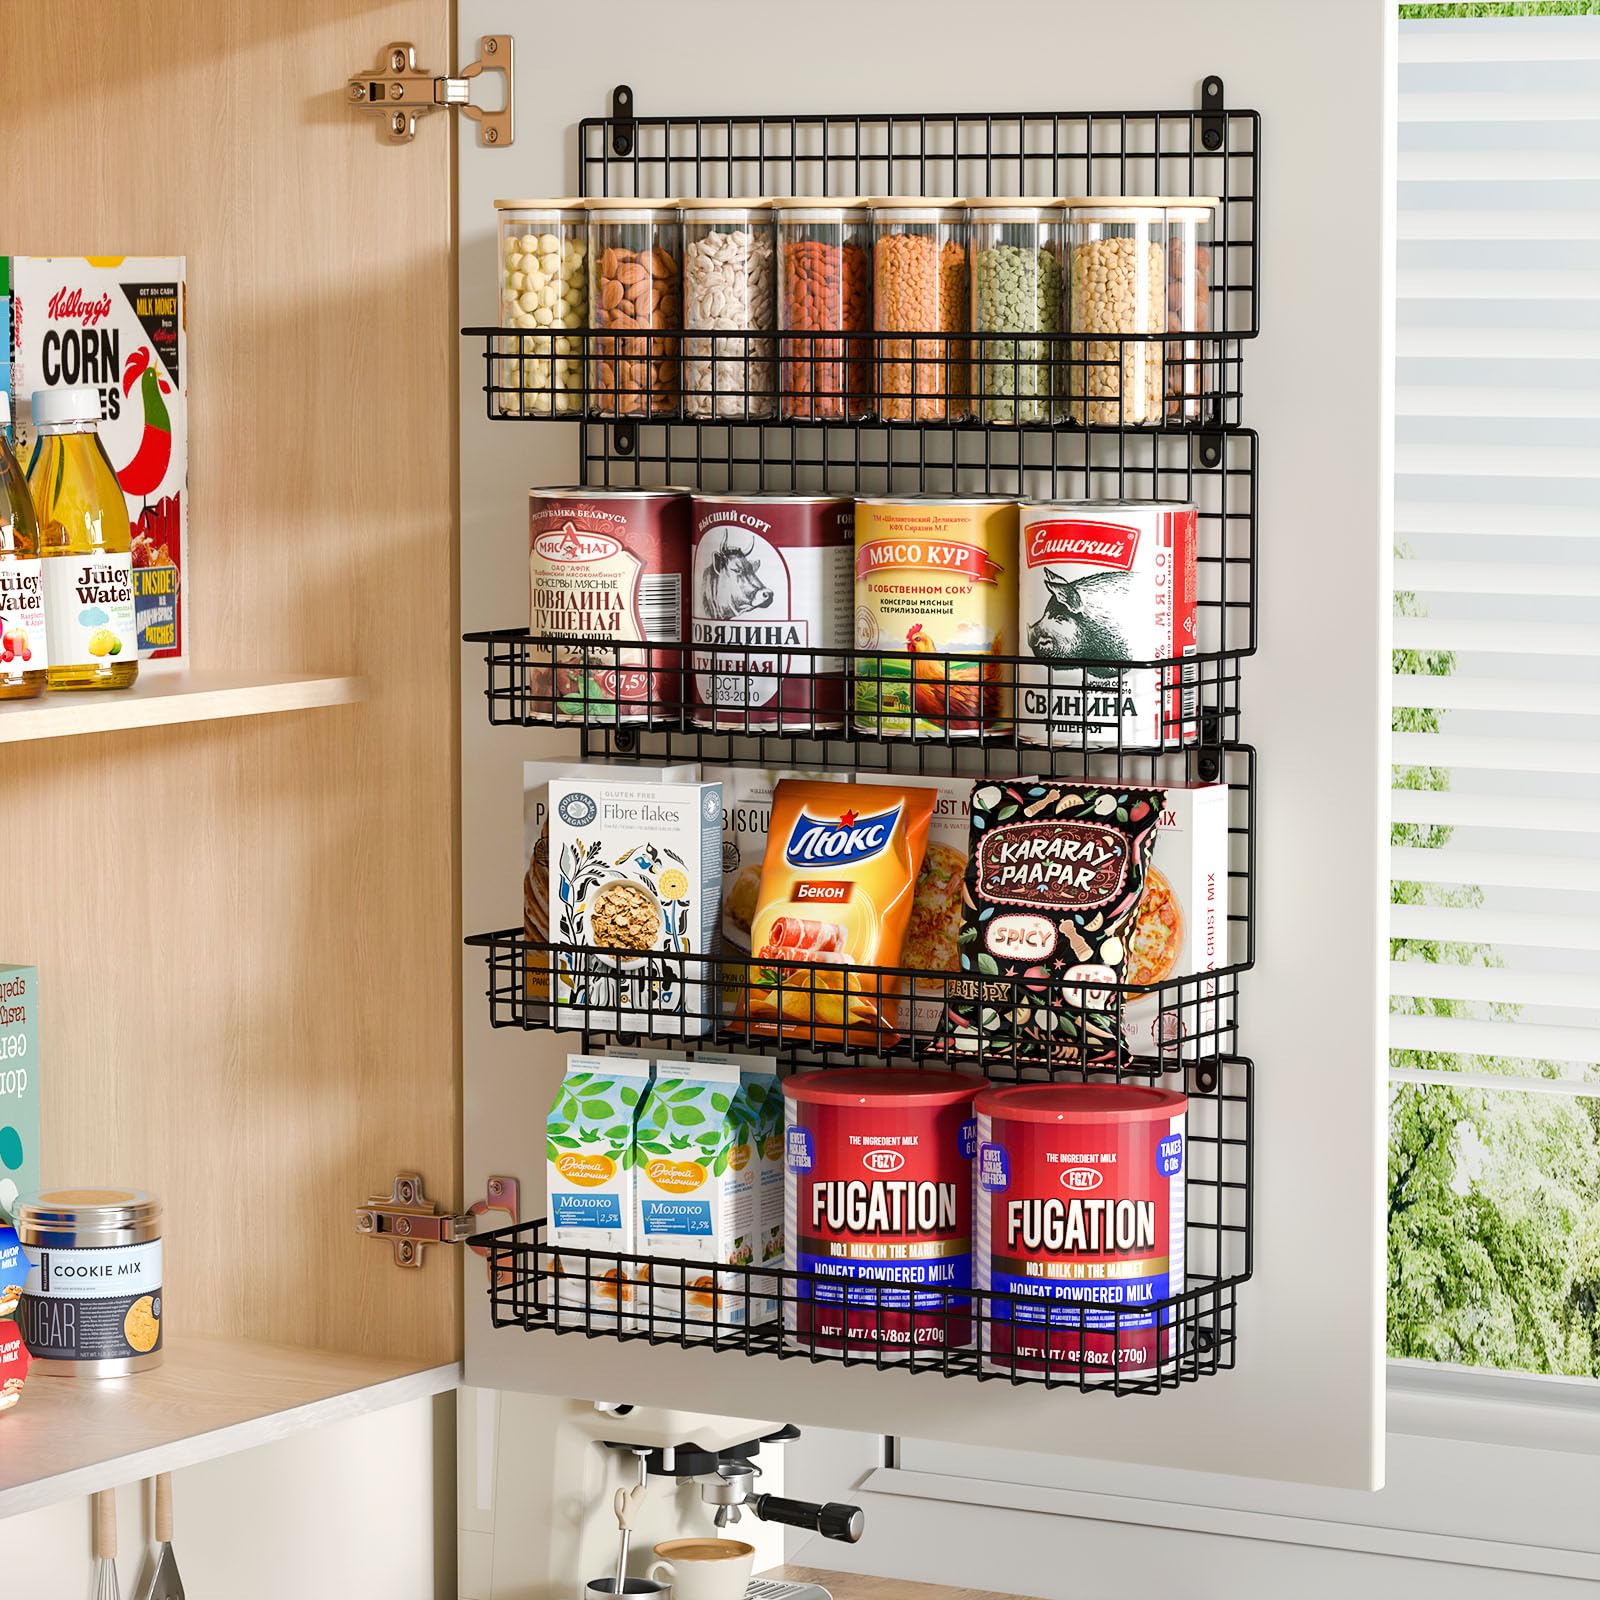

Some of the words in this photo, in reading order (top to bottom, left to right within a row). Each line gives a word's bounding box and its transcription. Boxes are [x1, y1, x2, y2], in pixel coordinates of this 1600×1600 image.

[48, 286, 112, 326] Kellogg's
[136, 298, 153, 316] MILK
[155, 298, 177, 316] MONEY
[42, 328, 120, 386] CORN
[577, 510, 627, 523] БЕЛАРУСЬ
[698, 510, 738, 532] ВЫСШИЙ
[740, 514, 772, 533] СОРТ
[1031, 529, 1125, 558] Елинский
[870, 545, 922, 566] МЯСО
[927, 546, 969, 566] КУР
[0, 573, 39, 594] uicy
[78, 565, 129, 587] Juicy
[142, 569, 175, 596] INSIDE!
[574, 580, 618, 589] МЯСНЫЕ
[76, 586, 131, 604] Water
[874, 585, 942, 594] СОБСТВЕННОМ
[945, 586, 973, 594] СОКУ
[880, 598, 918, 606] КОНСЕРВЫ
[880, 606, 954, 614] СТЕРИЛИЗОВАННЫЕ
[536, 610, 621, 631] ТУШЕНАЯ
[145, 623, 175, 645] PATCHES
[692, 623, 801, 645] ОВЯДИНА
[1025, 690, 1138, 716] СВИНИНА
[604, 803, 637, 820] Fibre
[640, 805, 680, 822] flakes
[933, 799, 957, 815] UST
[562, 813, 594, 826] ORGANIC
[722, 808, 769, 833] BISCU
[1160, 811, 1176, 827] IX
[1000, 837, 1113, 867] KARARAY
[1001, 863, 1097, 891] PAAPAR
[798, 885, 845, 898] Бекон
[1207, 872, 1215, 901] MIX
[994, 927, 1052, 948] SPICY
[1207, 906, 1215, 956] CRUST
[849, 1135, 861, 1145] THE
[863, 1136, 901, 1146] INGREDIENT
[902, 1136, 919, 1146] MILK
[1160, 1138, 1181, 1157] TAKES
[560, 1156, 604, 1172] Добрый
[871, 1154, 897, 1168] FGZY
[1046, 1152, 1058, 1163] THE
[1060, 1153, 1099, 1163] INGREDIENT
[1100, 1153, 1117, 1163] MILK
[1164, 1158, 1169, 1172] 6
[650, 1163, 695, 1178] Добрый
[1069, 1171, 1095, 1186] FGZY
[560, 1196, 611, 1208] Молоко
[650, 1203, 702, 1215] Молоко
[812, 1180, 957, 1233] FUGATION
[1008, 1198, 1155, 1252] FUGATION
[0, 1246, 19, 1259] LAVOR
[830, 1242, 847, 1256] NO.1
[850, 1243, 873, 1258] MILK
[876, 1245, 887, 1258] IN
[889, 1244, 907, 1258] THE
[909, 1242, 945, 1258] MARKET
[54, 1265, 113, 1277] COOKIE
[117, 1262, 141, 1276] MIX
[858, 1265, 925, 1283] POWDERED
[928, 1263, 955, 1282] MILK
[1026, 1262, 1044, 1276] NO.1
[1047, 1263, 1071, 1278] MILK
[1074, 1265, 1085, 1278] IN
[1087, 1264, 1105, 1278] THE
[1055, 1286, 1123, 1303] POWDERED
[1127, 1282, 1153, 1302] MILK
[913, 1328, 946, 1344] (270g
[2, 1350, 19, 1363] MILK
